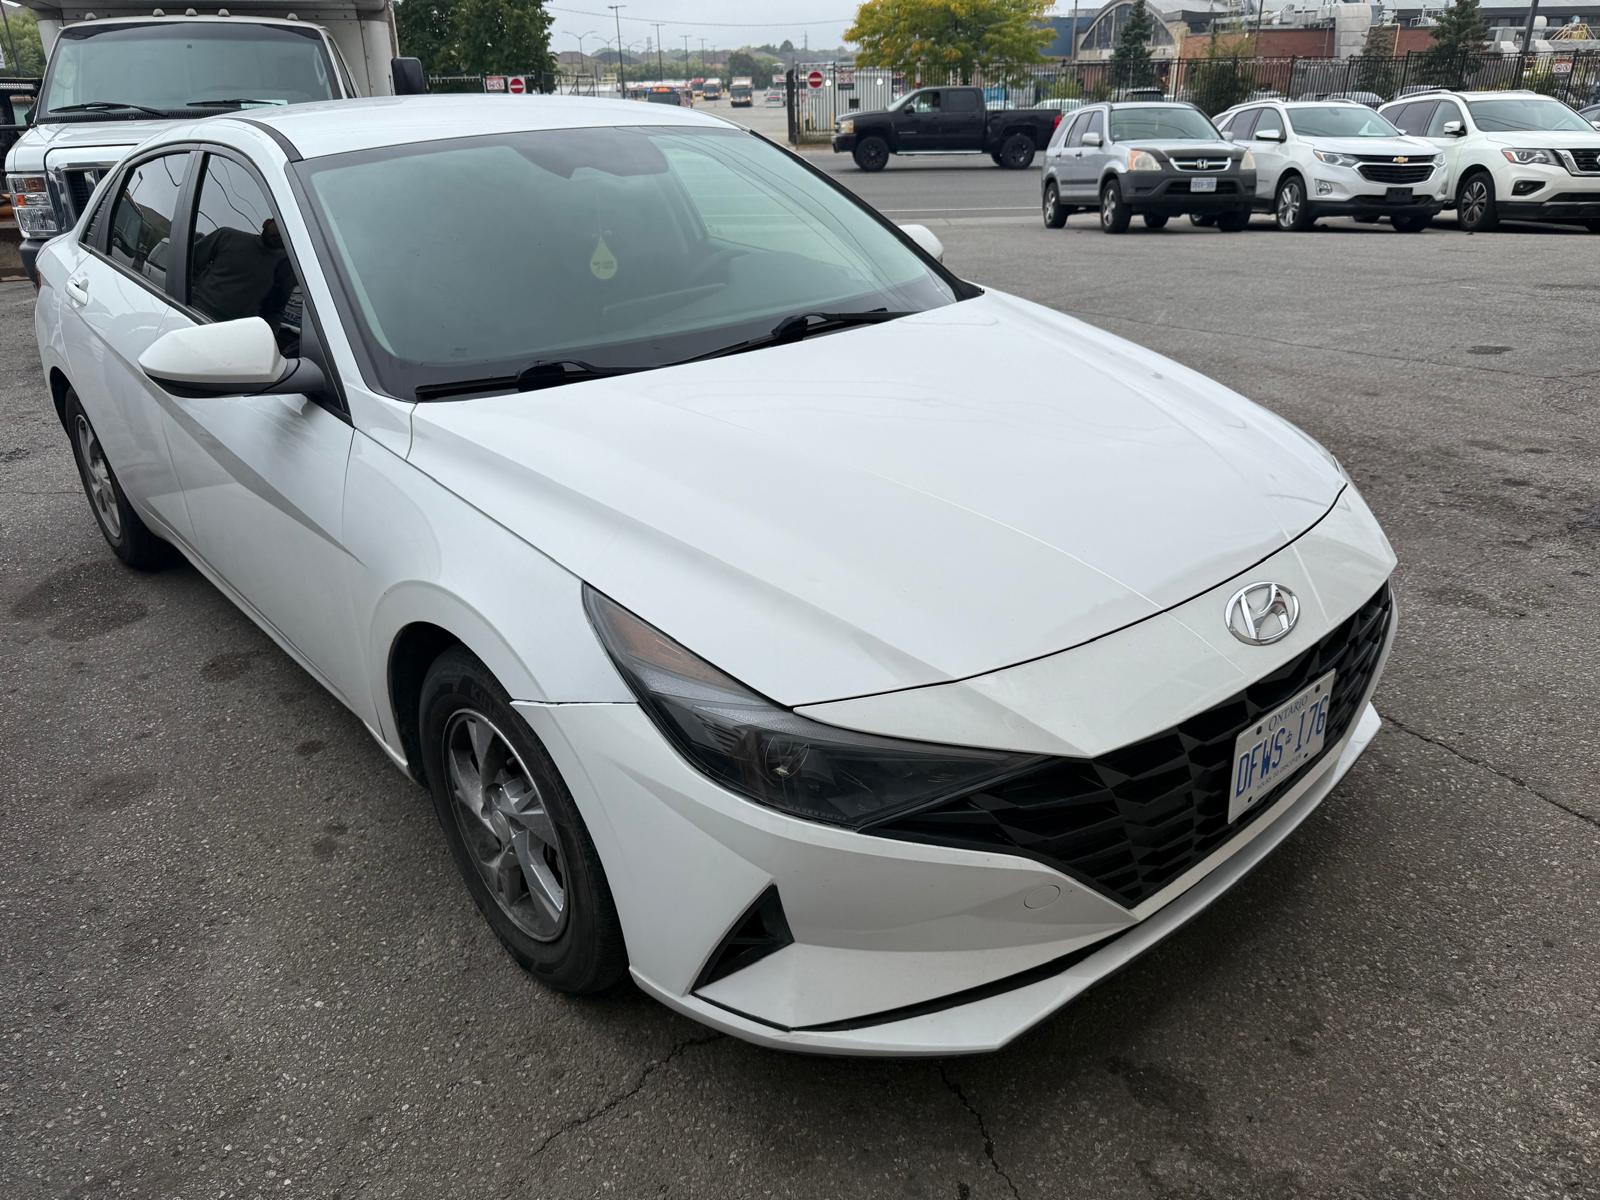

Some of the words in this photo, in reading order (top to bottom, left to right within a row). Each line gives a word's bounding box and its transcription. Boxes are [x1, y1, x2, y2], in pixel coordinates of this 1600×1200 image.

[1236, 727, 1286, 798] DFWS
[1294, 694, 1330, 753] 176
[1268, 694, 1309, 732] ONTARIO
